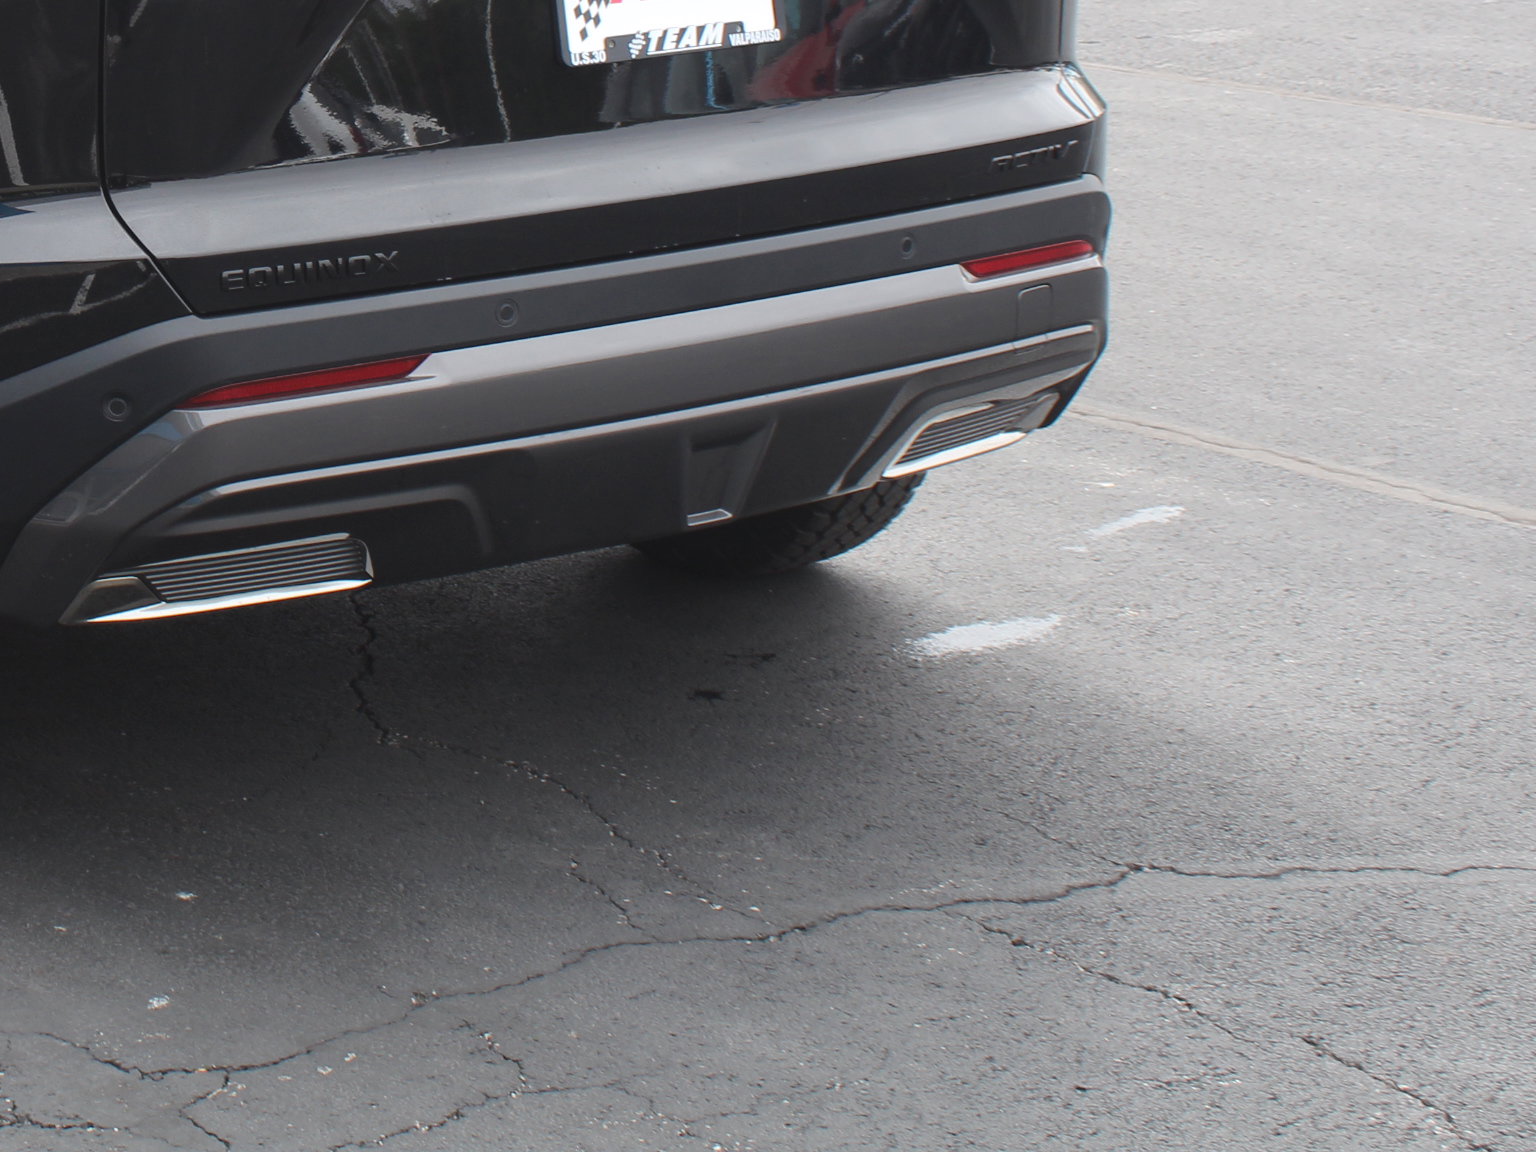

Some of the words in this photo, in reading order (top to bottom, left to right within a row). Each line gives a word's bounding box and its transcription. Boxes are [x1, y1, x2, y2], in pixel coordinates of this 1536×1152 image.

[646, 22, 725, 55] TEAM
[728, 28, 781, 47] VALPARAISO
[220, 250, 400, 292] EQUINOX
